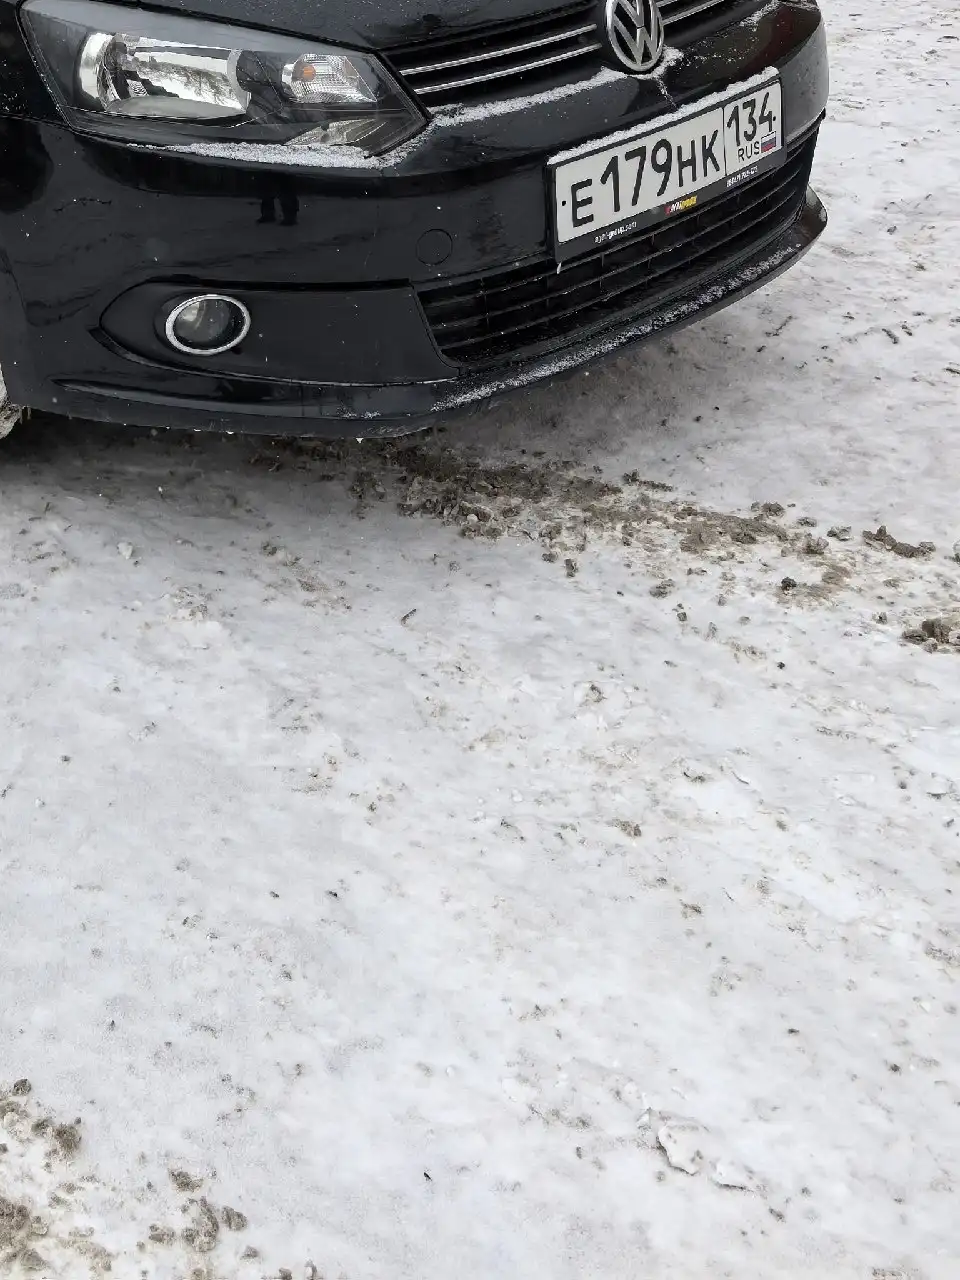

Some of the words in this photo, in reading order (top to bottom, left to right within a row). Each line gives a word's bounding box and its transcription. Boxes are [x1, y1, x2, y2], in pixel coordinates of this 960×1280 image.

[726, 91, 774, 147] 134
[571, 129, 720, 227] Е179НК
[737, 140, 760, 163] RUS
